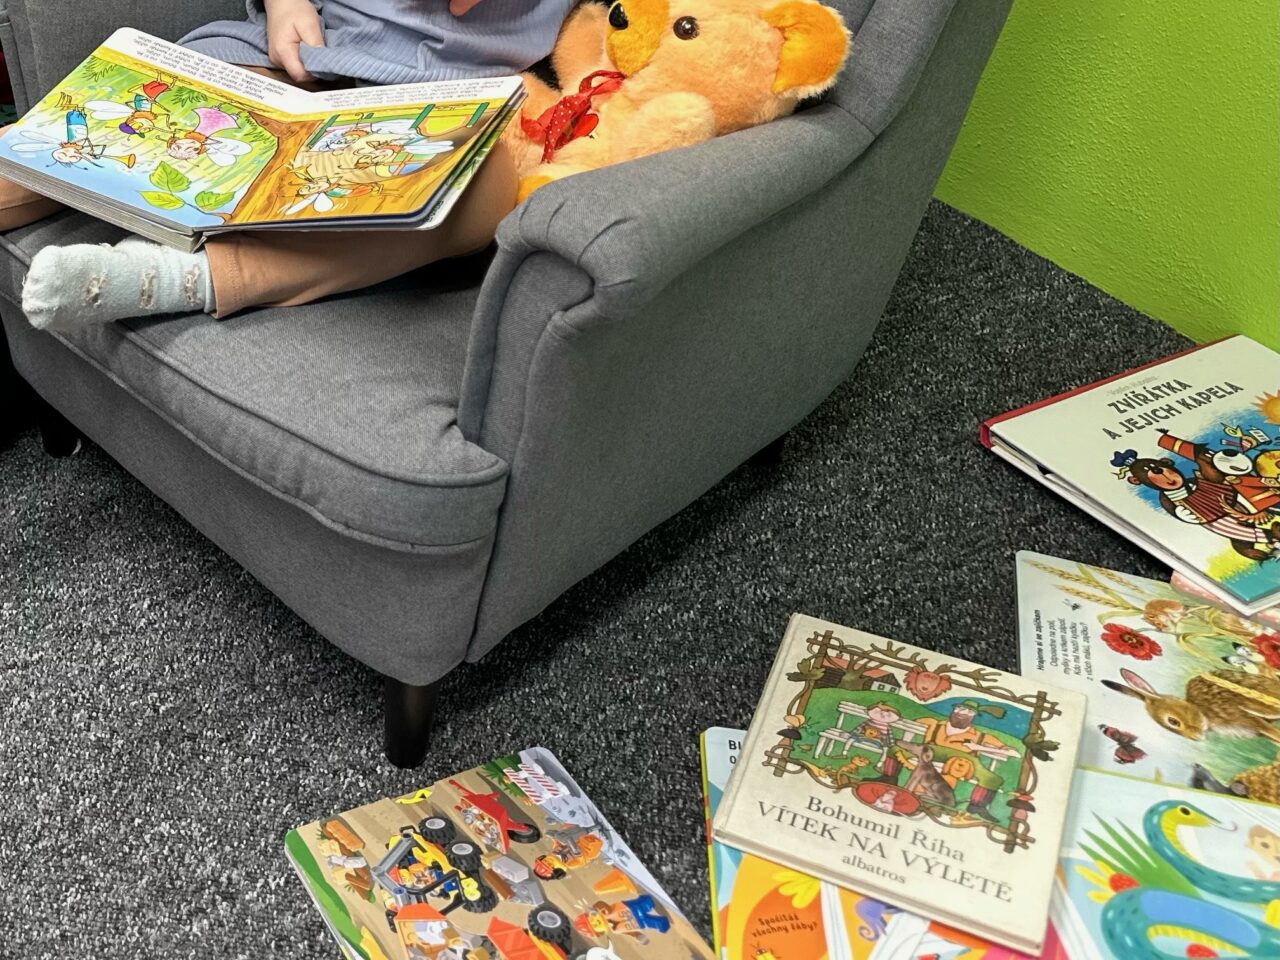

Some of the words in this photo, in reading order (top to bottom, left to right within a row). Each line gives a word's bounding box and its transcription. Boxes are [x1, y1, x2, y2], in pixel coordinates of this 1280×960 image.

[1102, 428, 1122, 440] A
[1119, 404, 1182, 433] JEJICH
[1176, 382, 1244, 410] KAPELA
[1107, 379, 1192, 414] ZVÍŘÁTKA
[757, 800, 841, 842] VÍTEK
[848, 832, 887, 859] NA
[901, 849, 1014, 903] VÝLETĚ
[805, 795, 901, 840] Bohumil
[911, 829, 965, 863] Říha
[841, 854, 907, 885] albatros
